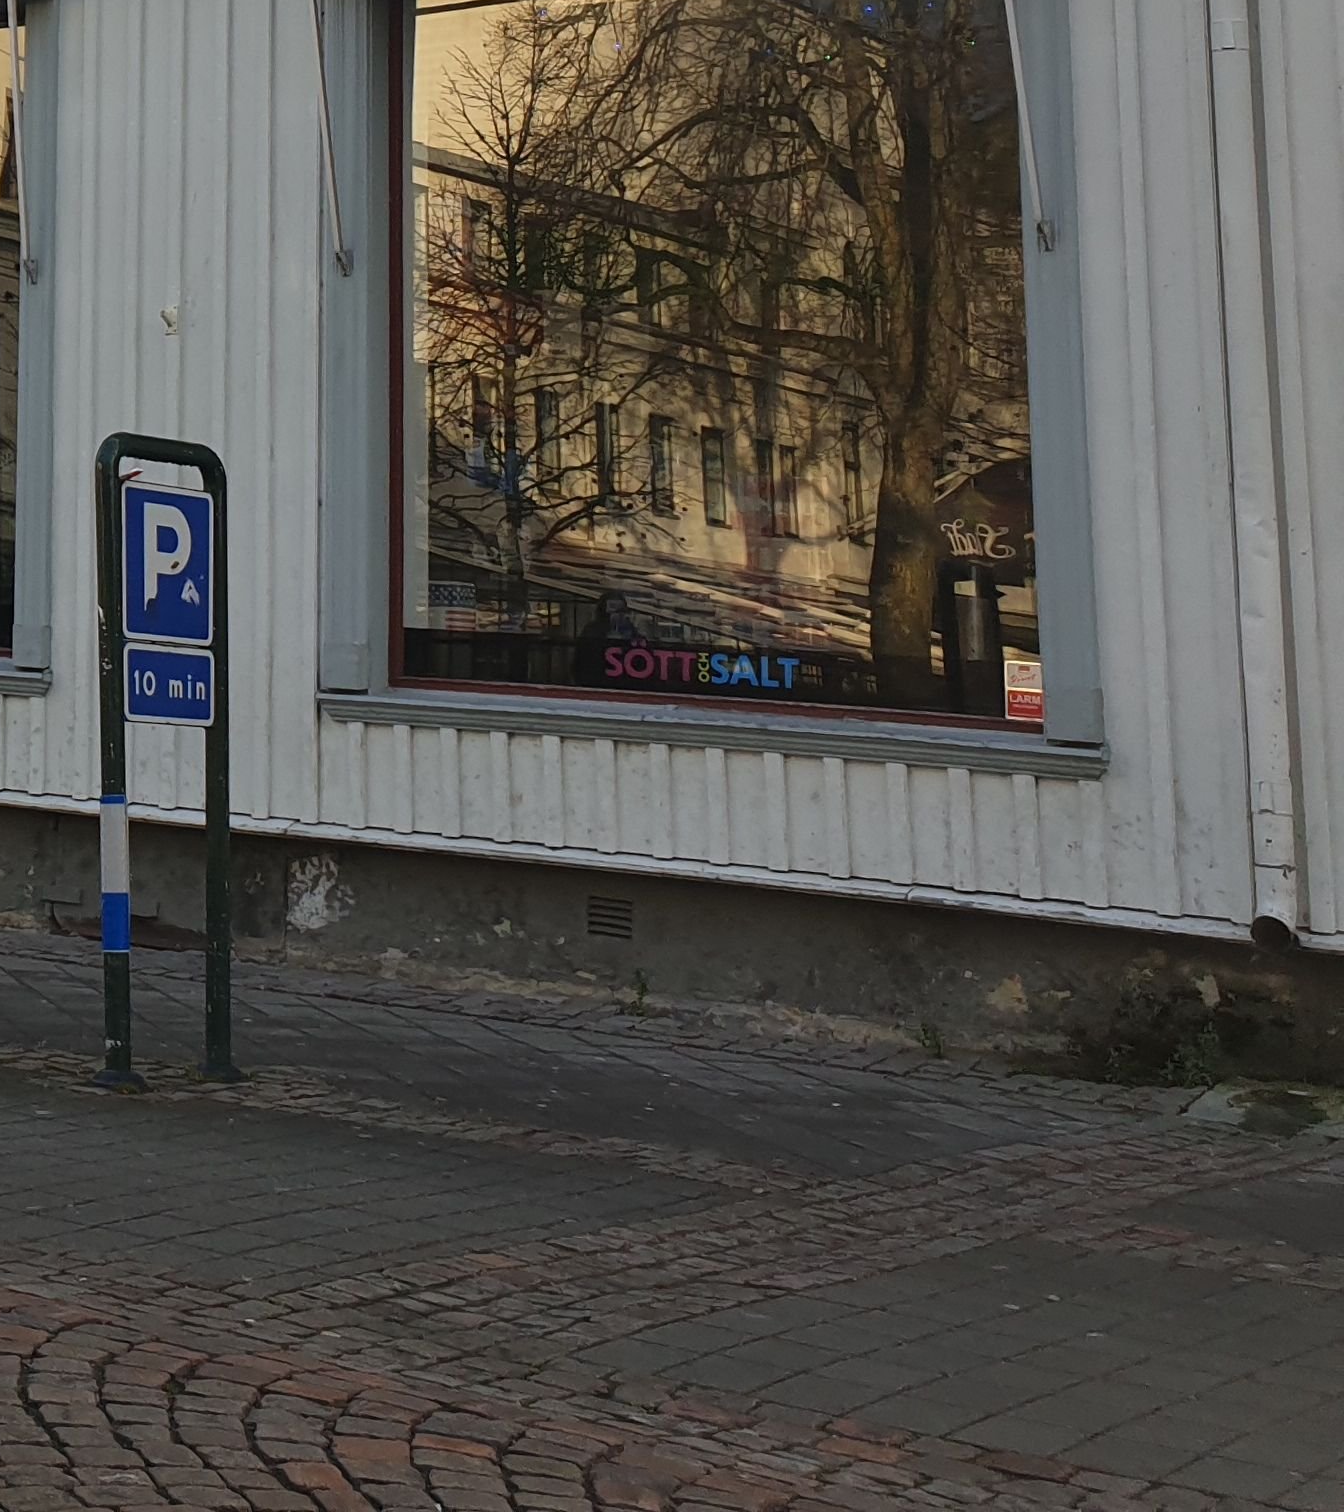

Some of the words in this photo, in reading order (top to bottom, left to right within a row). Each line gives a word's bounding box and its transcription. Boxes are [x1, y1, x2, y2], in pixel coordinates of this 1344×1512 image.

[144, 502, 191, 611] P
[134, 670, 155, 696] 10
[169, 674, 205, 700] min
[604, 640, 697, 682] SÖTT
[698, 652, 710, 682] OCH
[710, 653, 800, 689] SALT
